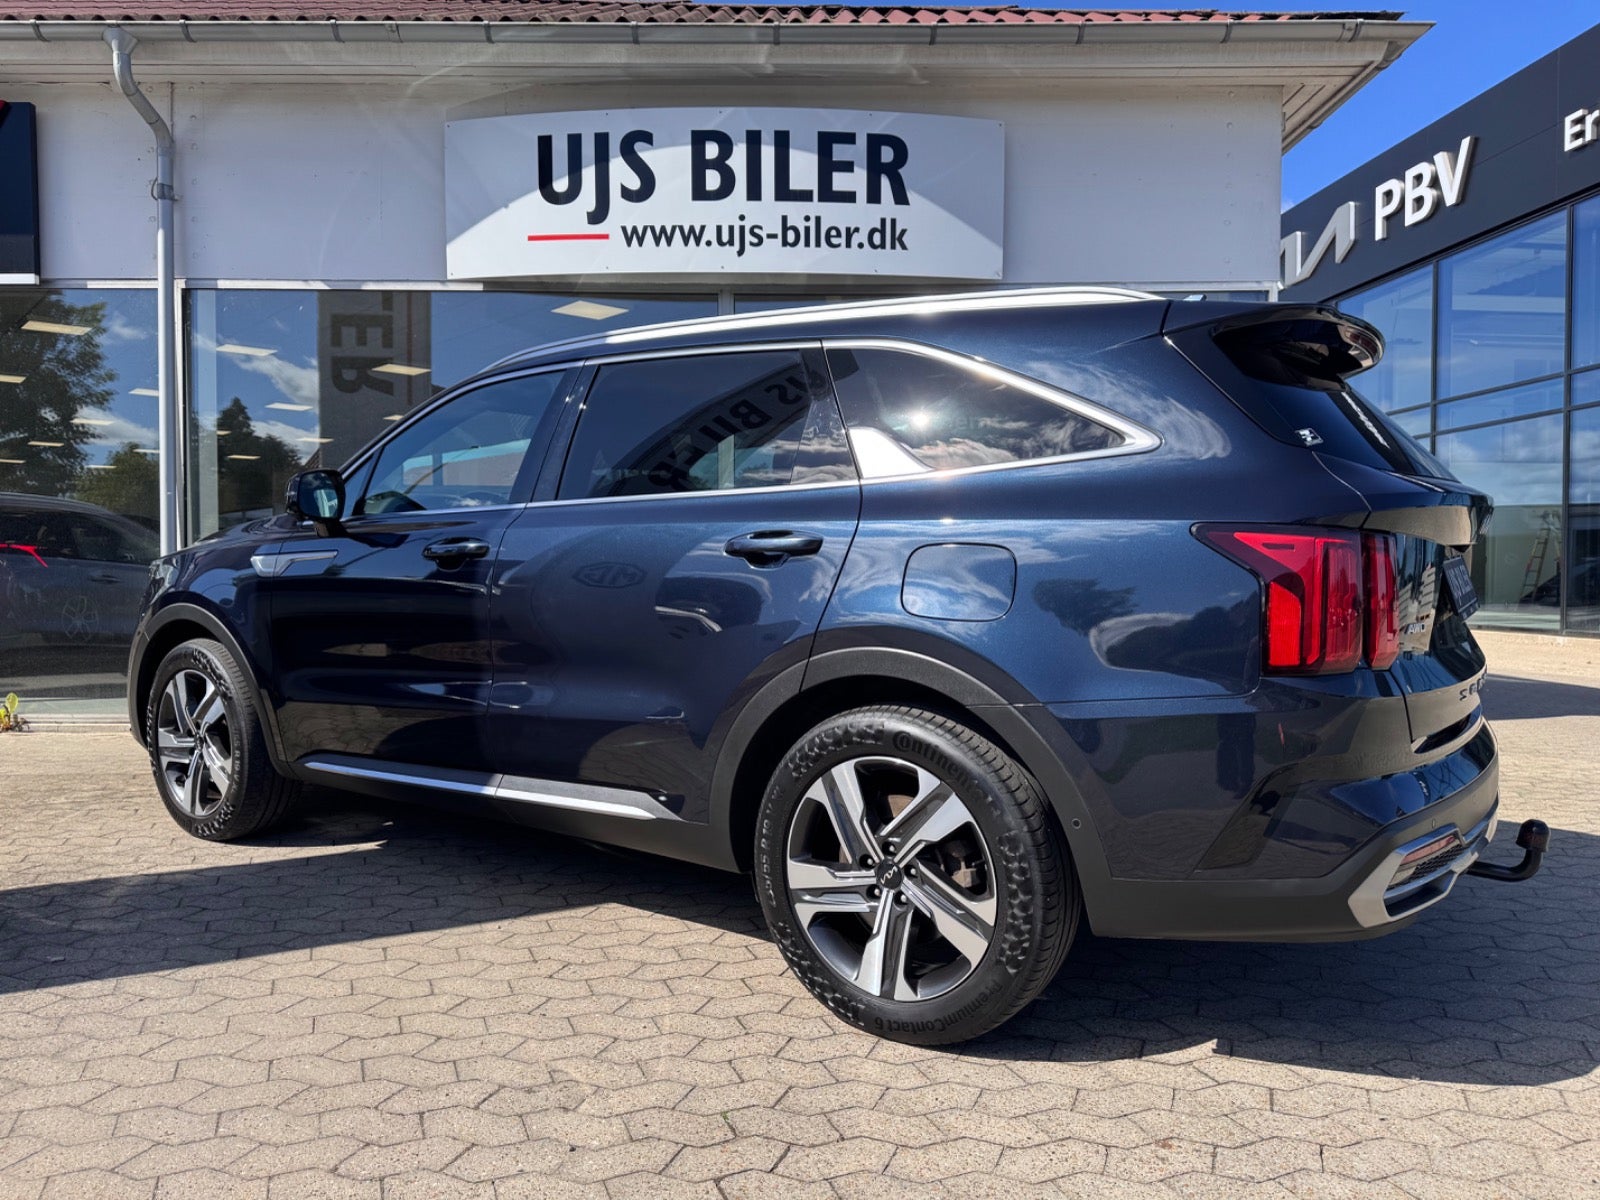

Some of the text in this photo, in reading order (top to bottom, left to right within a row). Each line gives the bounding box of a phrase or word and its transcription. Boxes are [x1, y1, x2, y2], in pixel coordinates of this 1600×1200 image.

[537, 129, 911, 225] UJS BILER
[1374, 135, 1477, 242] PBV
[621, 214, 909, 257] www.ujs-biler.dk
